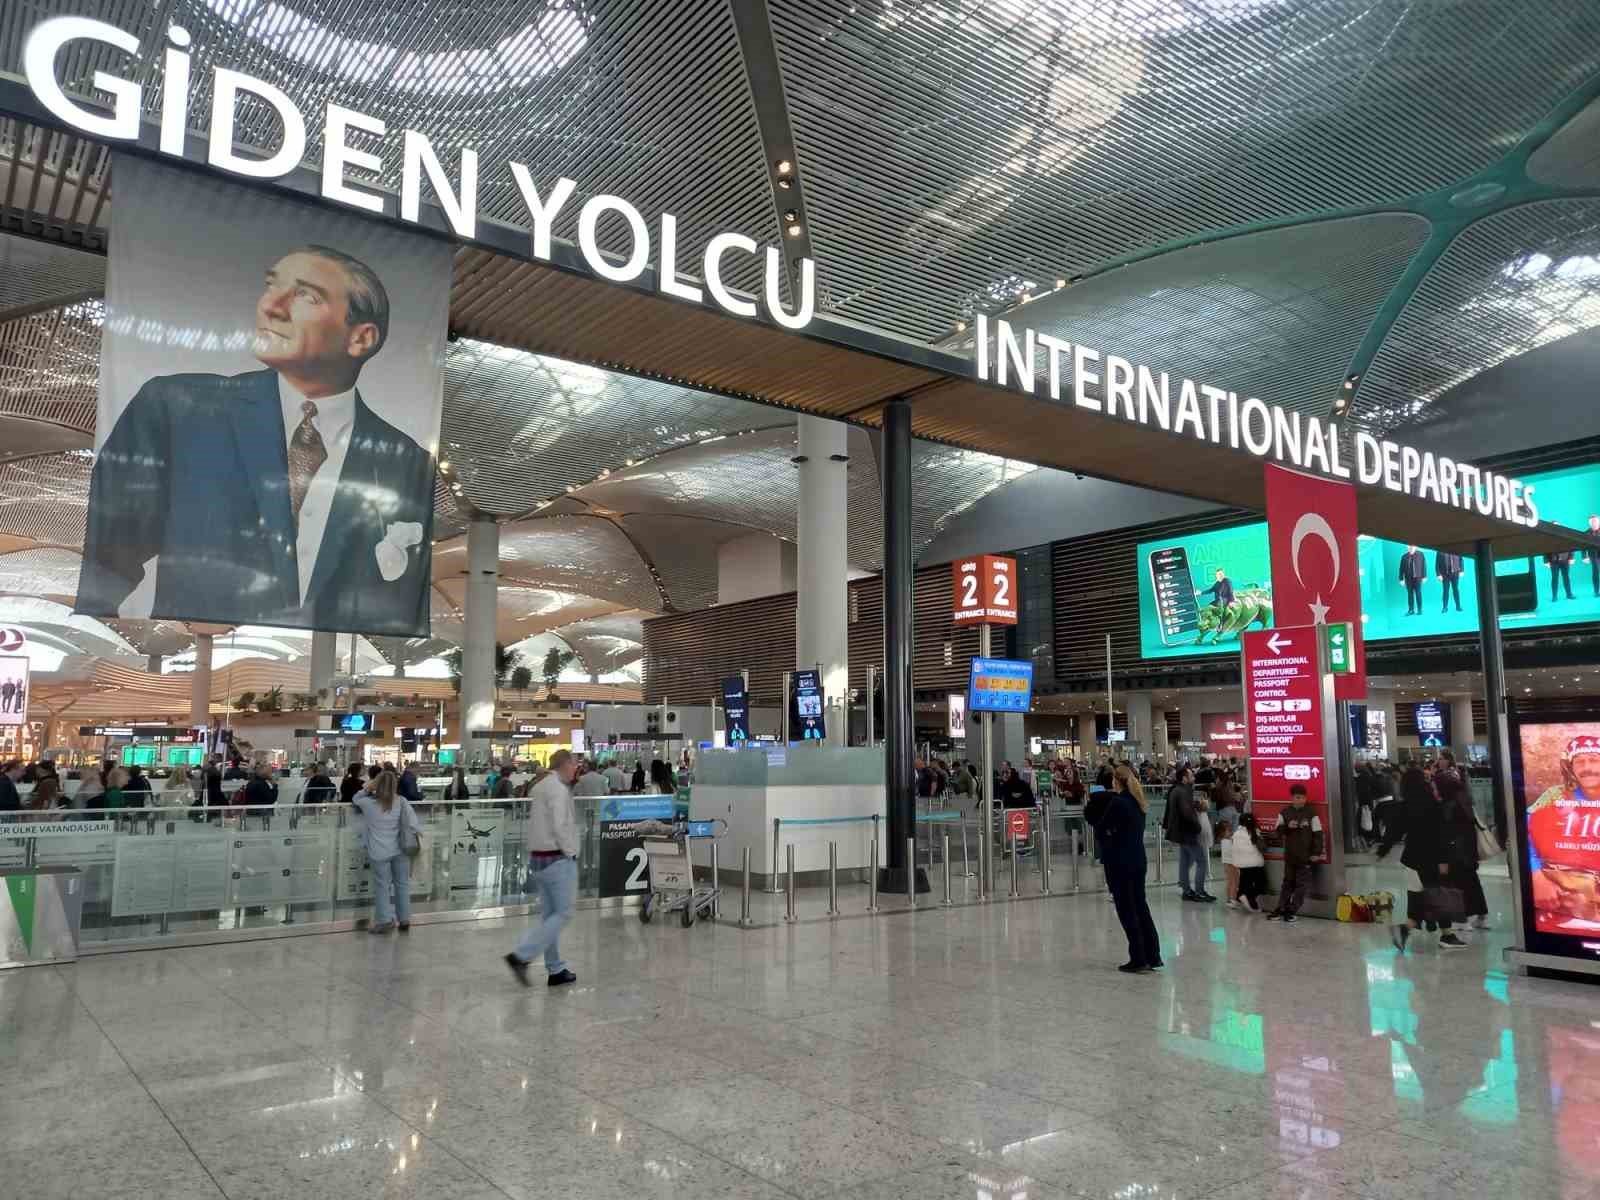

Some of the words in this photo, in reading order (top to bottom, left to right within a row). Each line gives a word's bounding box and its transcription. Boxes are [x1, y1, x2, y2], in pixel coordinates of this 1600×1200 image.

[509, 161, 815, 329] YOLCU
[977, 314, 1350, 477] INTERNATIONAL
[1357, 432, 1539, 527] DEPARTURES
[962, 575, 978, 607] 2
[993, 574, 1010, 606] 2
[954, 608, 985, 619] ENTRANCE
[986, 608, 1017, 618] ENTRANCE
[1252, 657, 1309, 667] INTERNATIONAL
[1253, 668, 1298, 677] DEPARTURES
[1254, 679, 1290, 688] PASSPORT
[1254, 690, 1288, 698] CONTROL
[1268, 714, 1297, 723] HATLAR
[1256, 724, 1279, 733] GİDEN
[1279, 724, 1303, 732] YOLCU
[1257, 736, 1294, 744] PASAPORT
[1257, 746, 1291, 754] KONTROL
[601, 830, 637, 840] PASSPORT
[625, 847, 648, 890] 2
